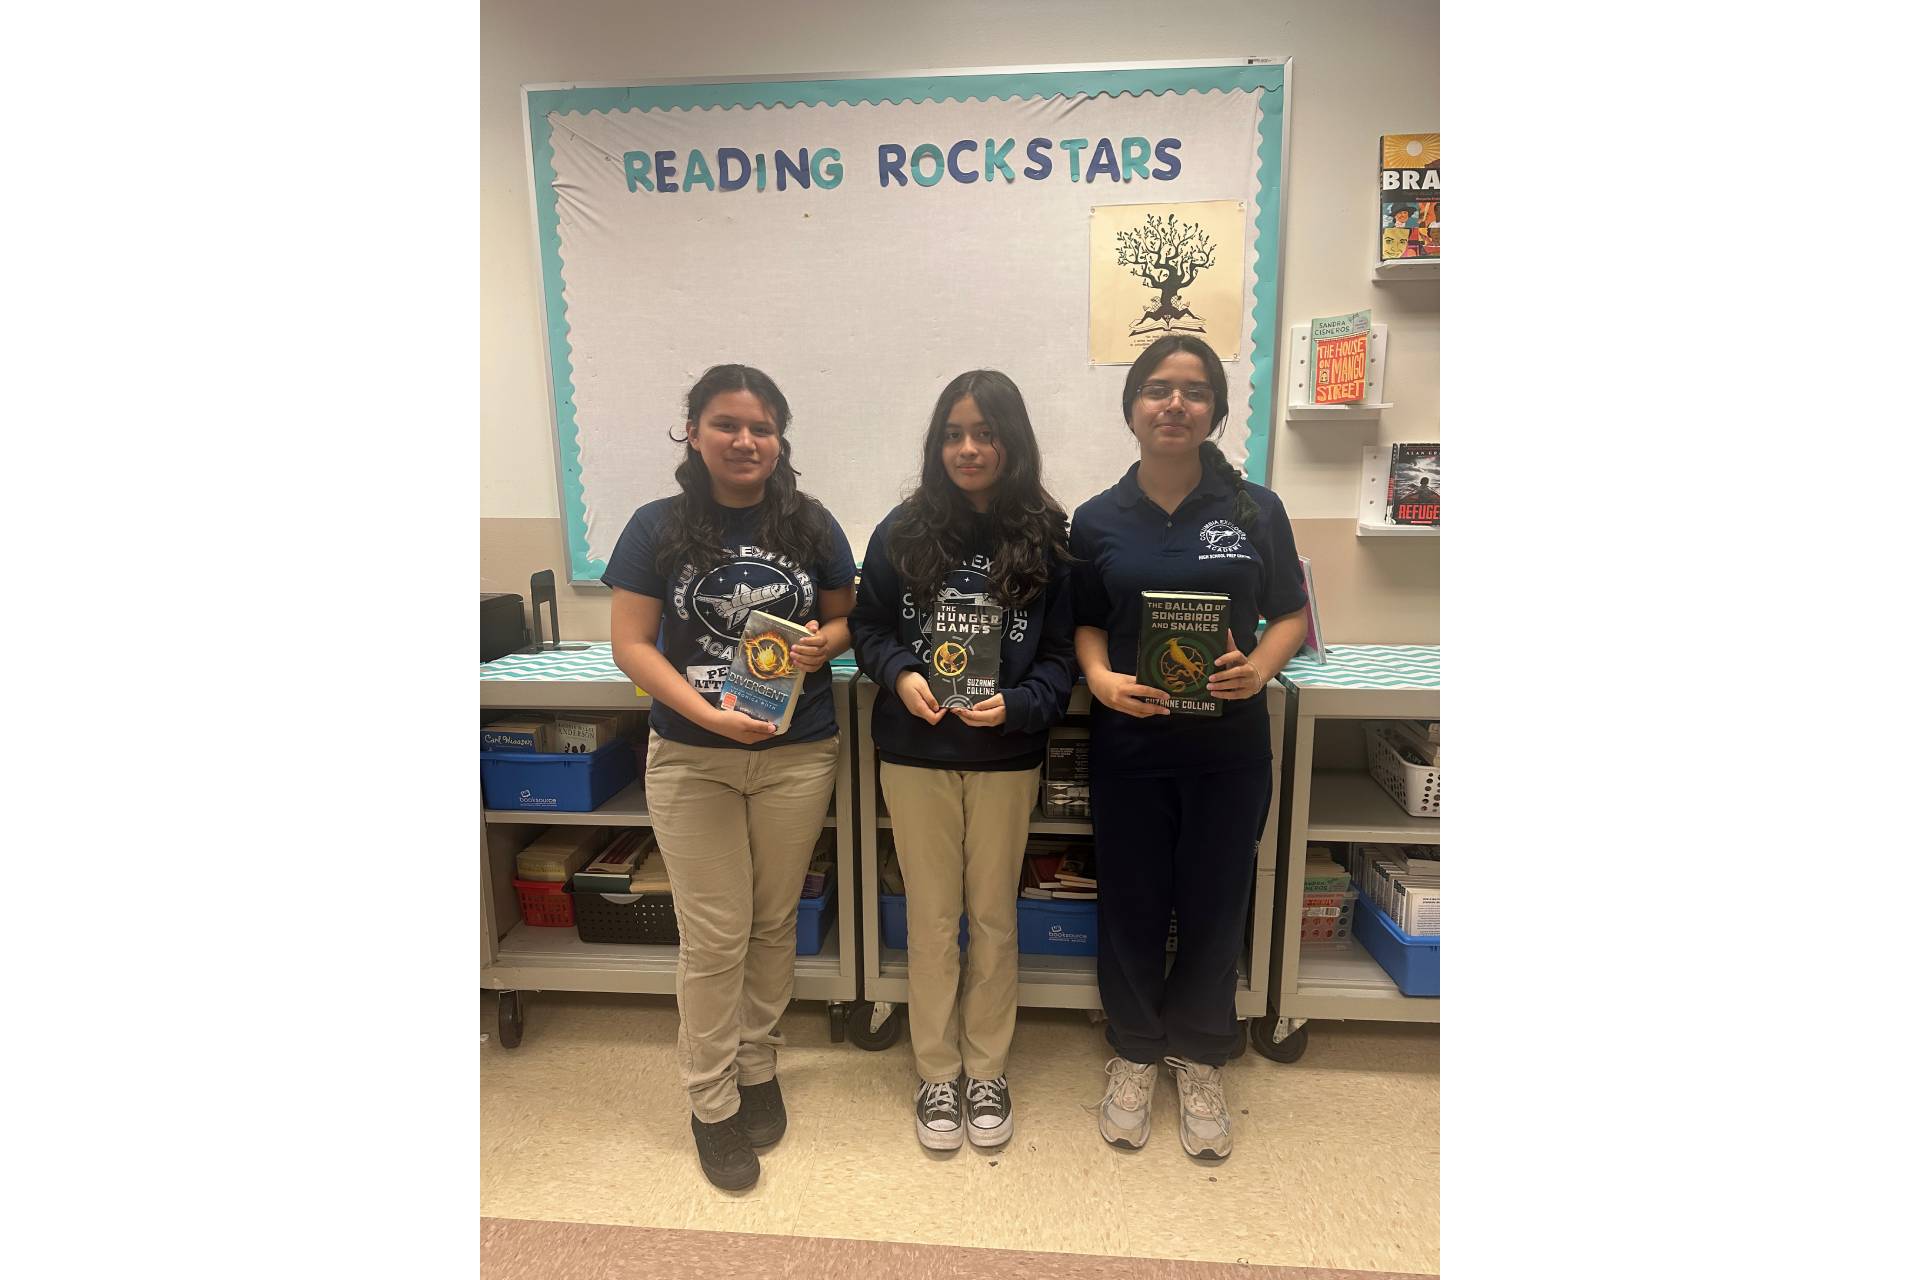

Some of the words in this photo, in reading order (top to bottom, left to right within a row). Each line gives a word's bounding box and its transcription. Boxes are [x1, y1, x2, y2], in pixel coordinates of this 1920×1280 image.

[623, 148, 844, 193] READING
[878, 137, 1182, 187] ROCKSTARS
[1319, 320, 1346, 329] SANDRA
[1314, 326, 1350, 336] CISNEROS
[1317, 344, 1334, 359] THE
[1335, 336, 1367, 358] HOUSE
[1319, 359, 1331, 369] ON
[1331, 352, 1365, 383] MANGO
[1316, 379, 1366, 402] STREET
[1205, 543, 1242, 553] ACADEMY
[1165, 602, 1213, 611] BALLAD
[937, 611, 999, 624] HUNGER
[1152, 611, 1220, 622] SONGBIRDS
[936, 622, 991, 634] GAMES
[1170, 622, 1219, 632] SNAKES
[728, 672, 789, 703] DIVERGENT
[966, 678, 995, 687] SUZANNE
[966, 686, 995, 696] COLLINS
[1182, 700, 1216, 711] COLLINS
